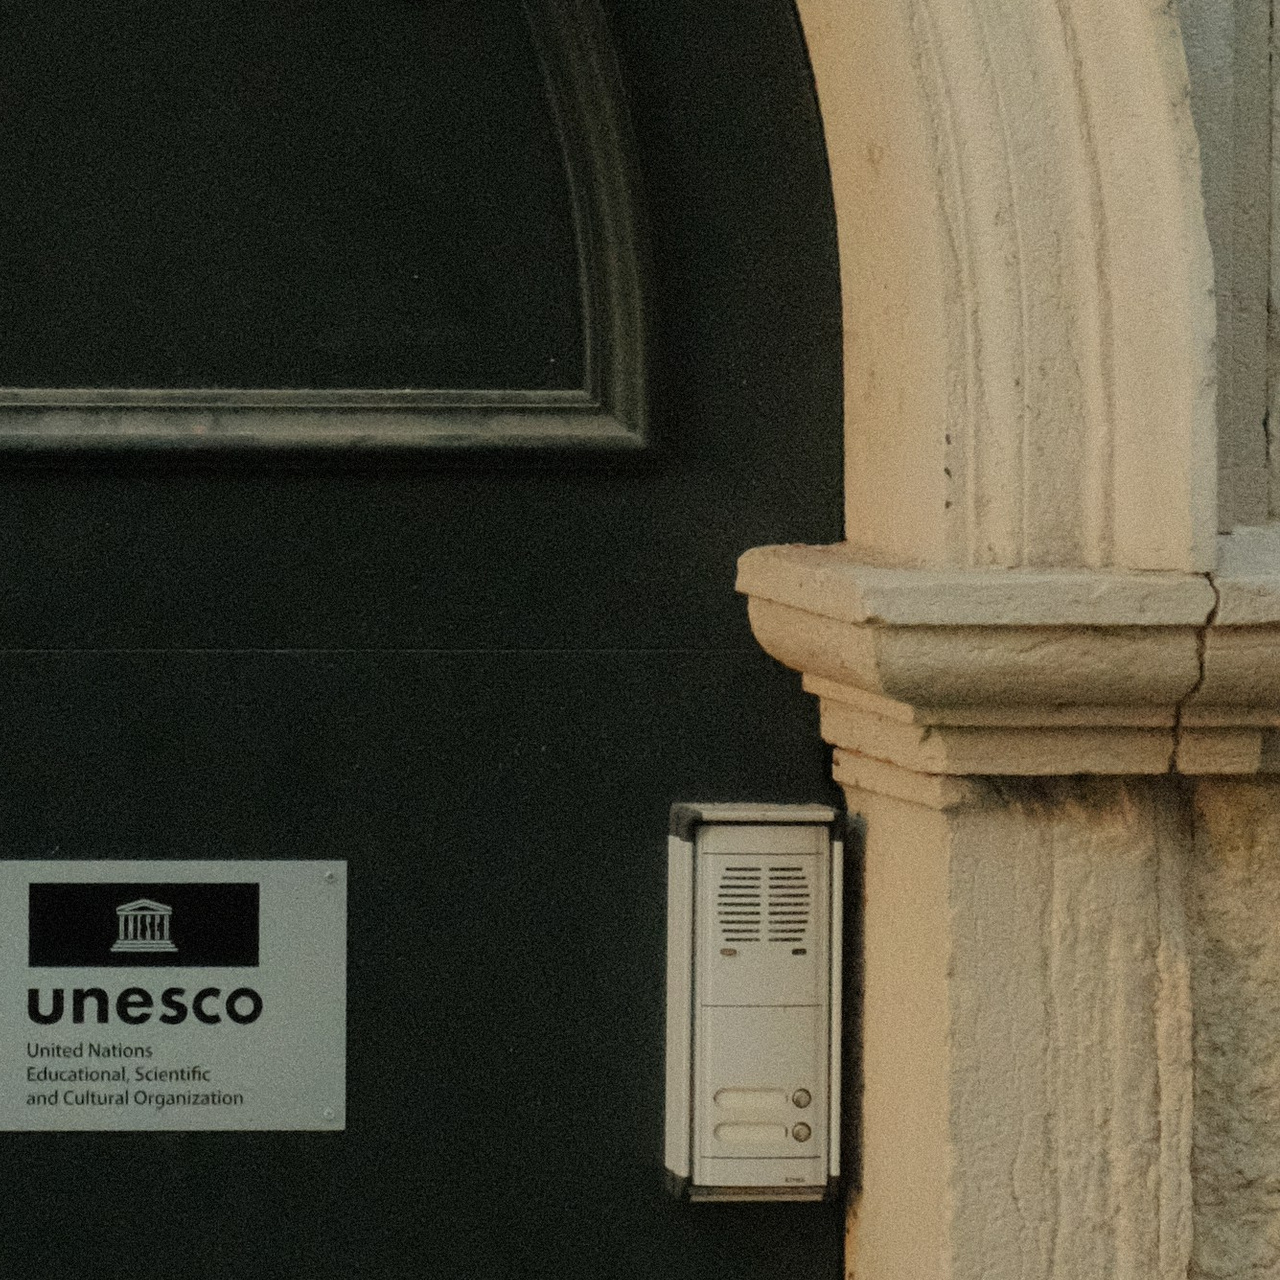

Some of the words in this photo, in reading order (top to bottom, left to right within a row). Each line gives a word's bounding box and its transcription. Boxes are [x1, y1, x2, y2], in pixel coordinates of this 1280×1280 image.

[27, 987, 263, 1026] unesco
[26, 1043, 83, 1059] United
[88, 1043, 153, 1059] Nations
[26, 1067, 130, 1084] Educational,
[135, 1066, 210, 1082] Scientific
[26, 1090, 58, 1106] and
[63, 1090, 129, 1106] Cultural
[133, 1090, 244, 1110] Organization
